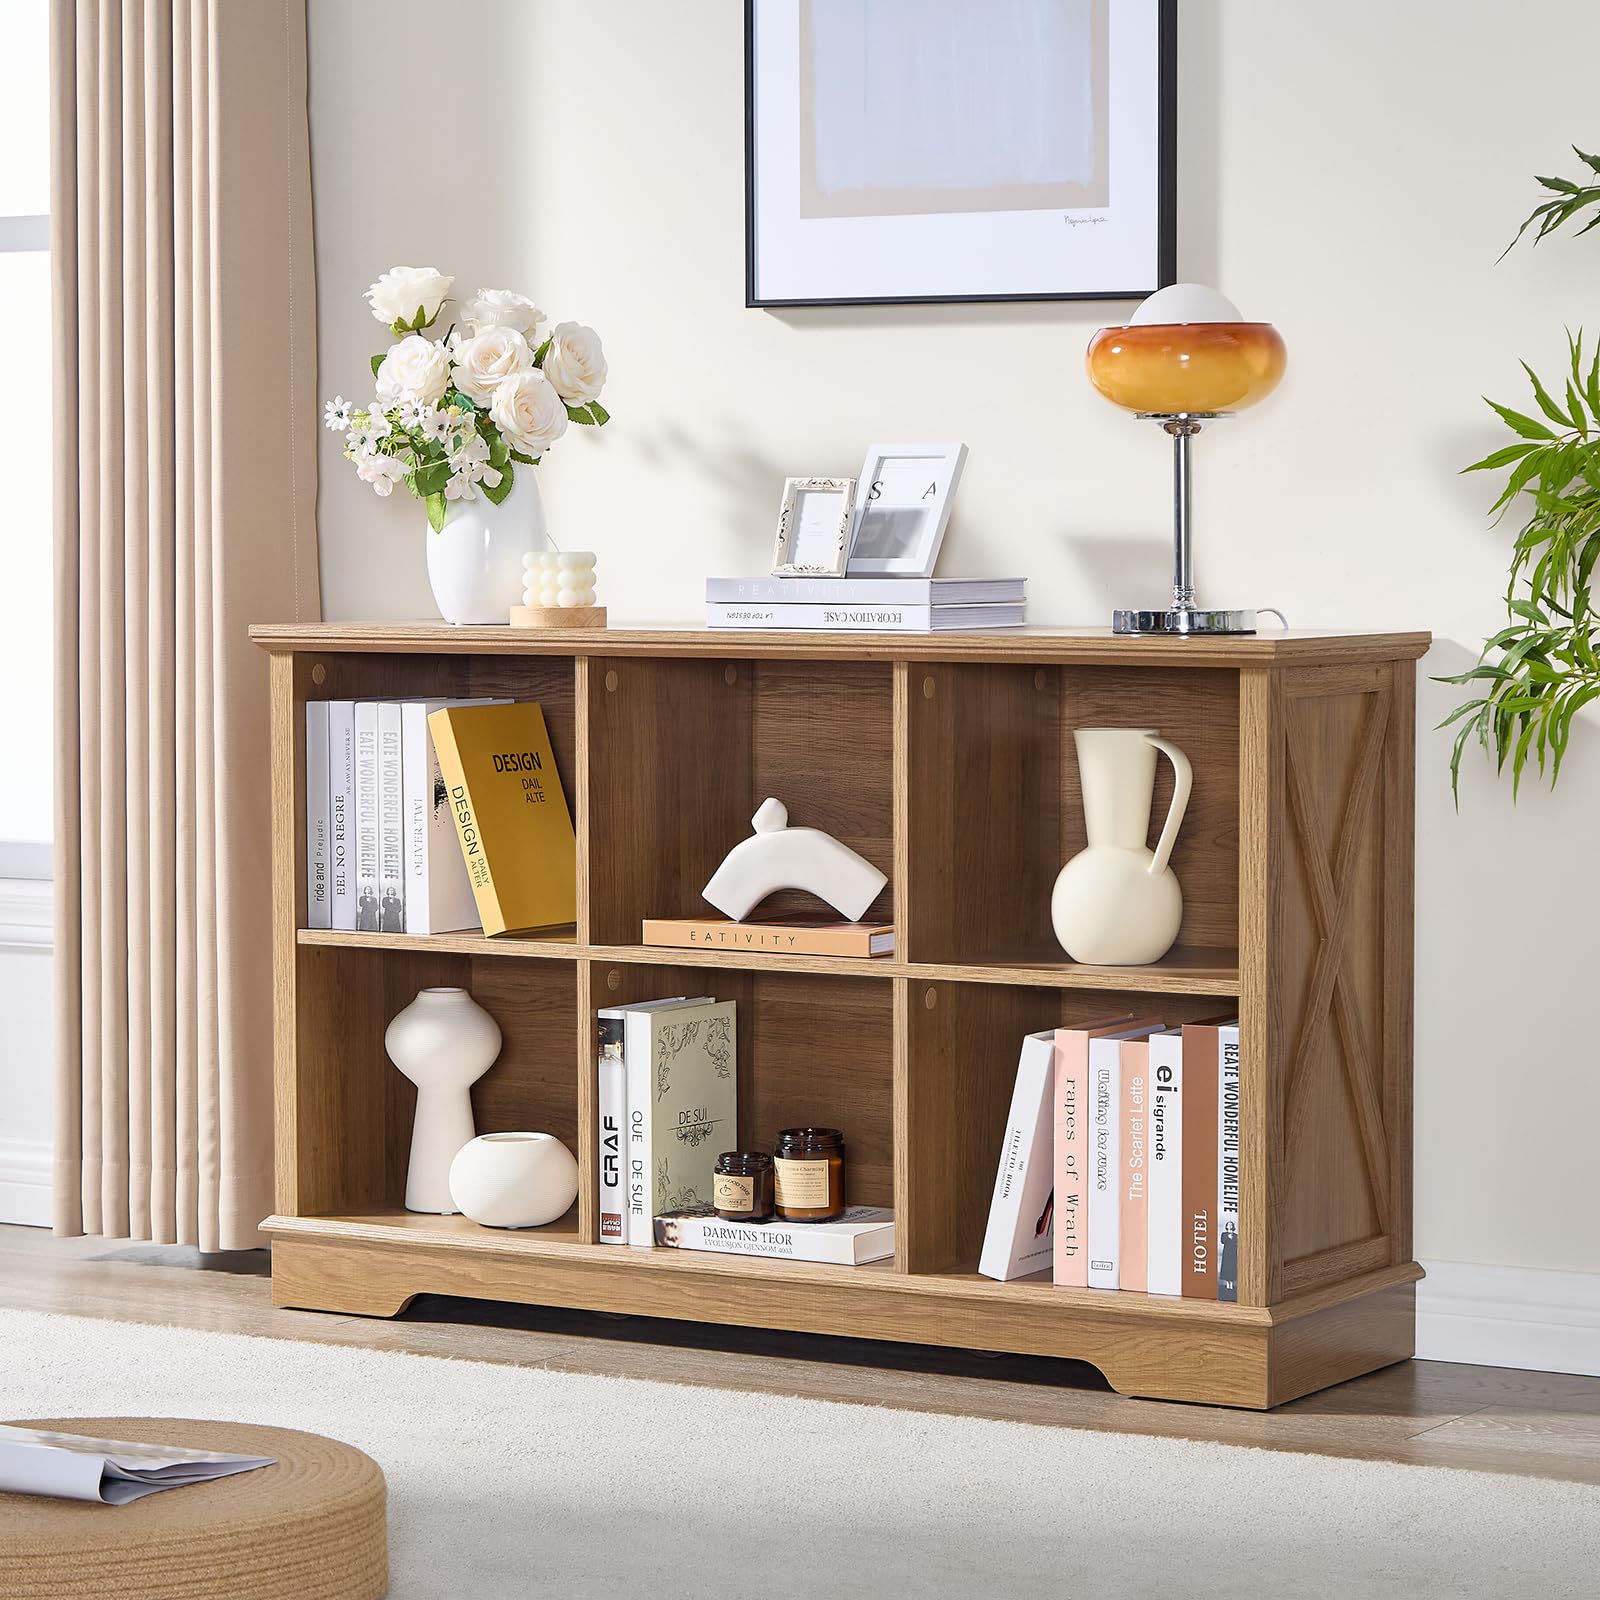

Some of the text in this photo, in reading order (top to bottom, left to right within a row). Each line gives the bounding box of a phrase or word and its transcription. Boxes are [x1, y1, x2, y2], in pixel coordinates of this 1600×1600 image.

[738, 584, 857, 598] REATIVITY
[824, 611, 902, 623] ECORATION CASE
[492, 751, 543, 773] DESIGN
[521, 778, 543, 790] DAIL
[525, 791, 546, 804] ALTE
[360, 731, 376, 878] EATE WONDERFUL HOMELIFE
[383, 732, 399, 880] EATE WONDERFUL HOMELIFE
[452, 786, 479, 855] DESIGN
[336, 795, 346, 896] EEL NO REGRE
[414, 828, 423, 876] OLIVER
[314, 820, 325, 902] ride and Prejudic
[470, 860, 483, 888] ALTER
[477, 858, 490, 885] DAILY
[690, 930, 797, 946] EATIVITY
[1095, 1069, 1110, 1125] Waiting
[679, 1107, 708, 1125] DE SUI
[1152, 1095, 1167, 1161] sigrande
[1223, 1043, 1239, 1213] REATE WONDERFUL HOMELIFE
[603, 1114, 619, 1187] CRAF
[1097, 1128, 1110, 1150] for
[1129, 1076, 1144, 1200] The Scarlet Lette
[631, 1160, 643, 1180] DE
[1062, 1078, 1079, 1258] rapes of Wrath
[631, 1184, 643, 1216] SUIE
[1002, 1173, 1013, 1200] BOOK
[702, 1226, 793, 1246] DARWINS TEOR
[704, 1238, 743, 1250] EVOLUSJON
[1193, 1209, 1208, 1274] HOTEL
